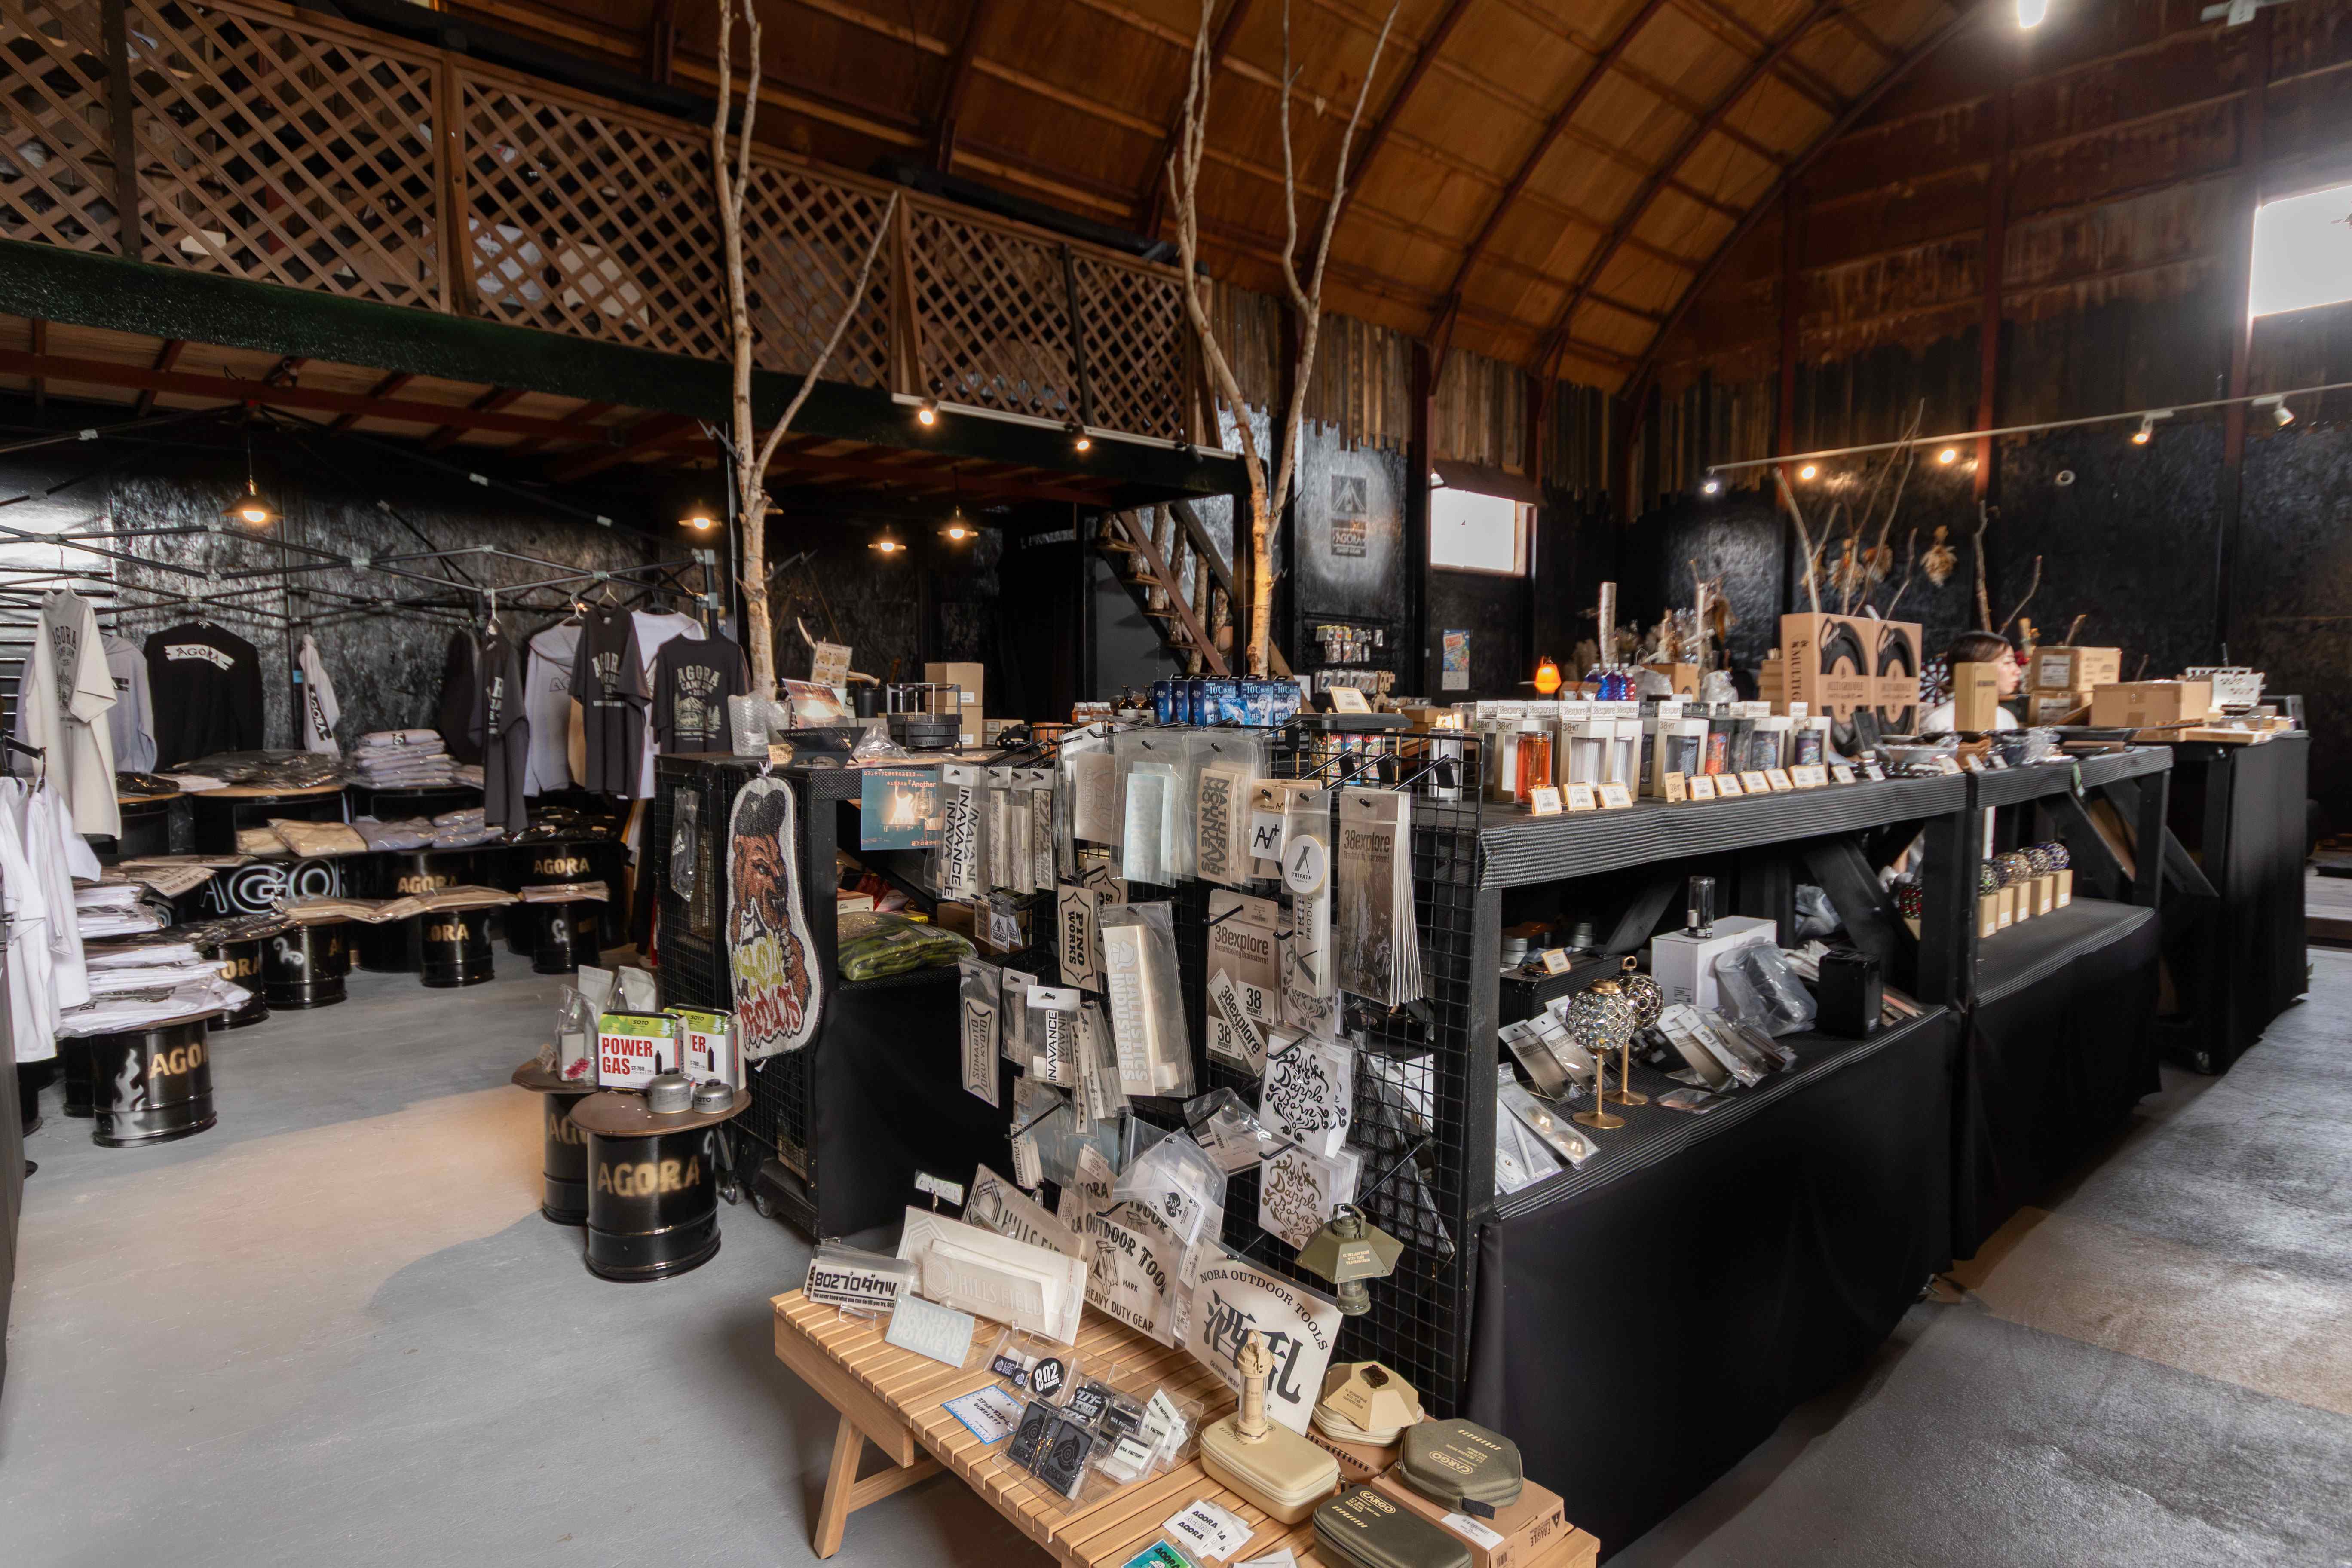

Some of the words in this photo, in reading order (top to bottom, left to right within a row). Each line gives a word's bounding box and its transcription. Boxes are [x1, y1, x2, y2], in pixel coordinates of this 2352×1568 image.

[176, 645, 219, 661] AGORA
[677, 665, 720, 688] AGORA
[1479, 705, 1497, 714] 38explo
[952, 789, 969, 888] INAVANCE
[1344, 829, 1390, 853] 38explore
[533, 858, 591, 875] AGORA
[1292, 872, 1312, 881] TRIPATH
[1068, 911, 1076, 965] WORKS
[1076, 912, 1085, 966] PINO
[1215, 925, 1269, 956] 38explore
[1215, 943, 1241, 959] Breathtaking
[1242, 950, 1268, 965] Brainstorm!
[1246, 988, 1262, 1010] 38
[1221, 985, 1261, 1054] 38explore
[1246, 1007, 1262, 1016] explore
[1112, 972, 1135, 1081] INDUSTRIES
[1125, 972, 1148, 1081] BALLISTICS
[1217, 1023, 1231, 1044] 38
[602, 1037, 653, 1057] POWER
[971, 1019, 981, 1080] SOMABITO
[980, 1019, 989, 1088] OKU-KYOTO
[1048, 1011, 1057, 1081] INAVANCE
[1217, 1040, 1232, 1050] explore
[148, 1042, 209, 1079] AGO
[602, 1057, 630, 1075] GAS
[597, 1155, 701, 1198] AGORA
[1086, 1212, 1137, 1257] OUTDOOR
[1122, 1279, 1139, 1293] MARK
[1086, 1286, 1109, 1309] HEAVY
[1111, 1301, 1132, 1321] DUTY
[1133, 1312, 1154, 1335] GEAR
[1200, 1269, 1228, 1284] NORA
[1231, 1270, 1294, 1306] OUTDOOR
[1295, 1302, 1328, 1351] TOOLS
[1035, 1362, 1059, 1392] 802
[1228, 1376, 1240, 1389] HEAV
[1432, 1452, 1471, 1473] CARGO
[1363, 1491, 1395, 1513] CARGO
[1530, 1525, 1551, 1547] FRAGILE
